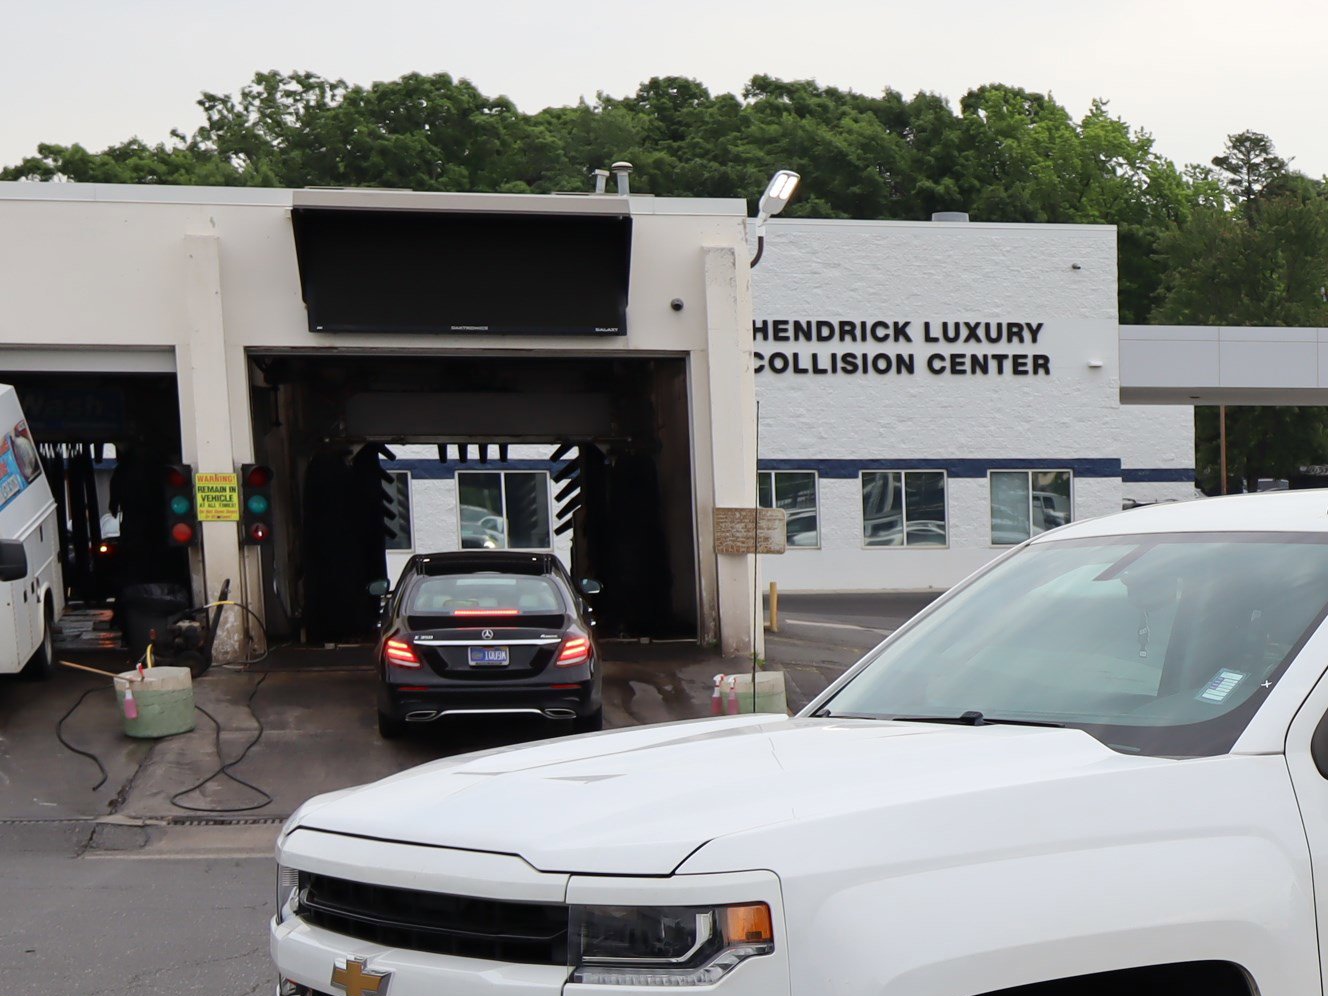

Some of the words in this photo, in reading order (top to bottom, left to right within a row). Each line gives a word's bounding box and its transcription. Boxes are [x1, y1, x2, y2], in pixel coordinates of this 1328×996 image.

[752, 320, 913, 343] HENDRICK
[924, 321, 1044, 344] LUXURY
[753, 351, 915, 375] COLLISION
[927, 353, 1051, 376] CENTER
[197, 475, 236, 483] WARNING!
